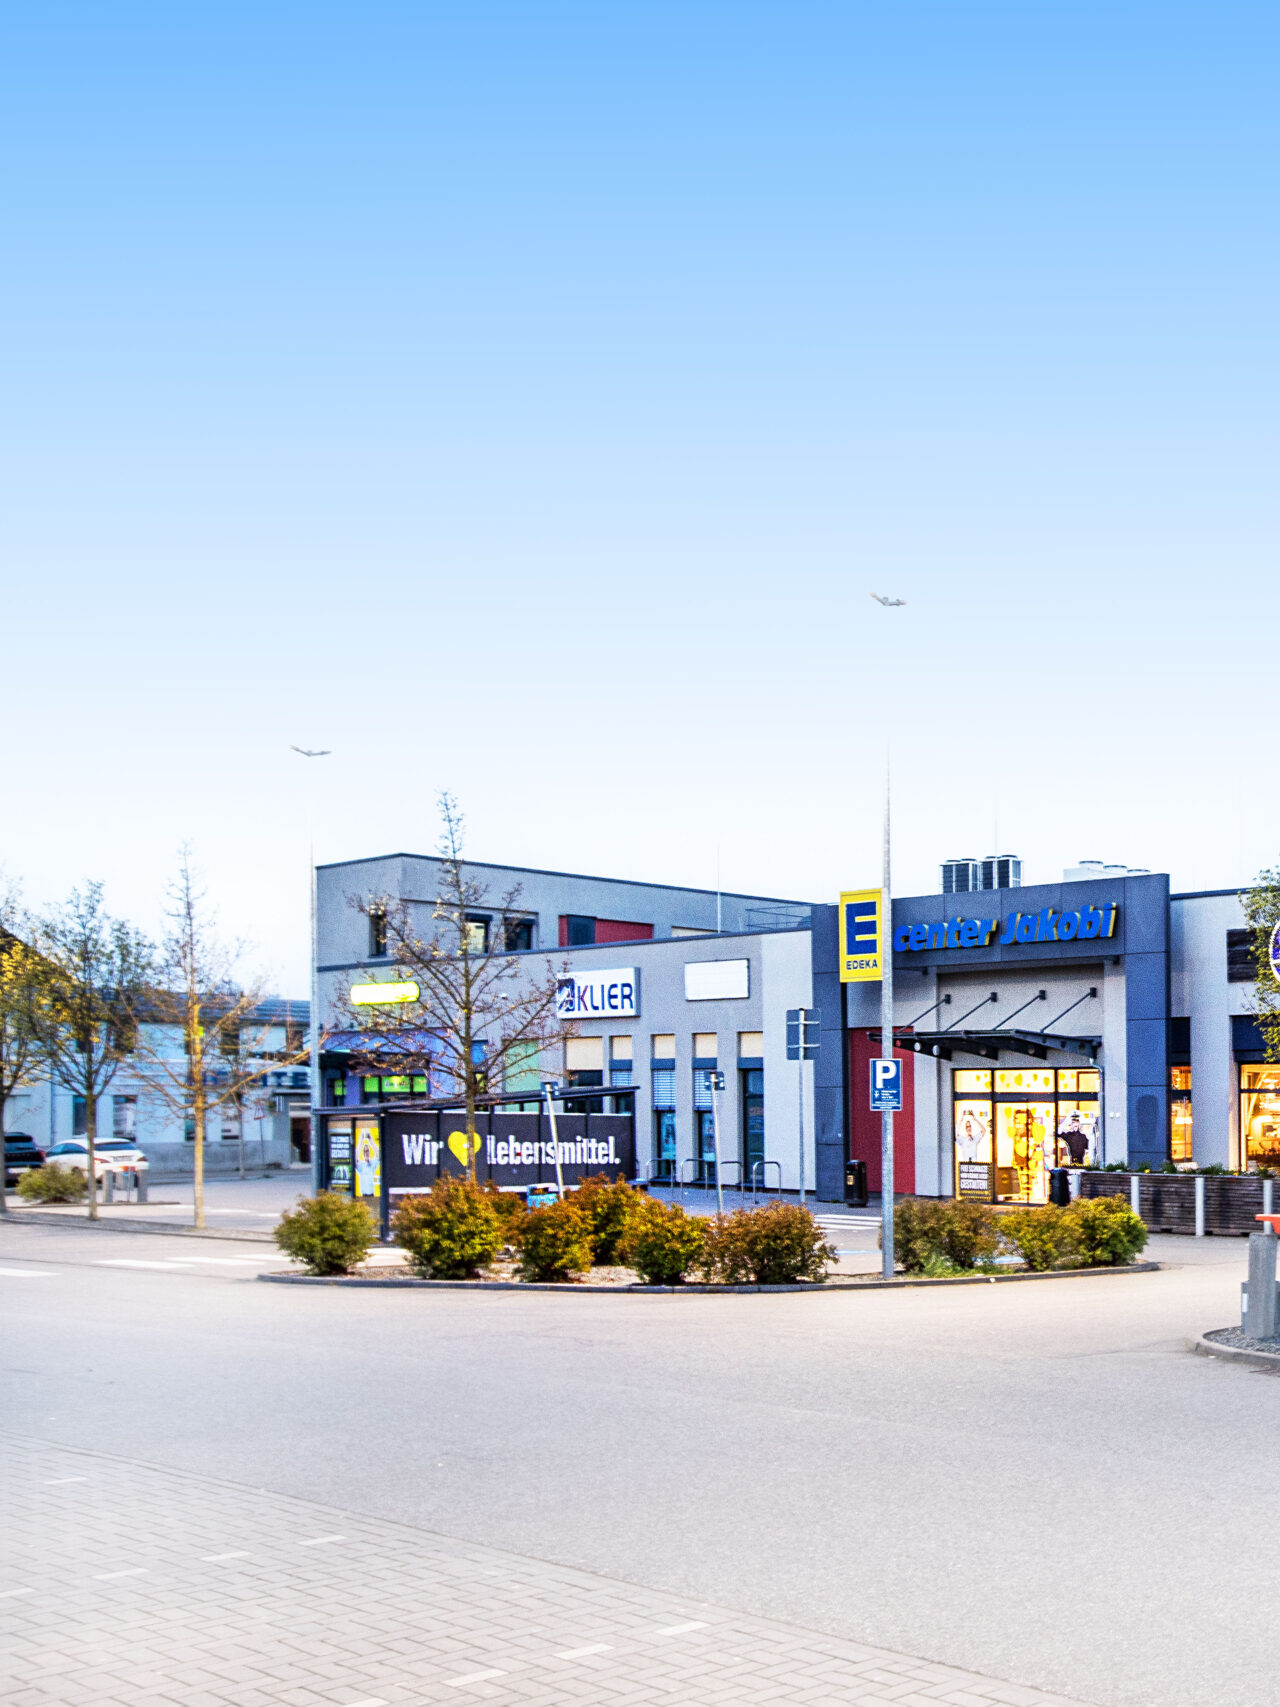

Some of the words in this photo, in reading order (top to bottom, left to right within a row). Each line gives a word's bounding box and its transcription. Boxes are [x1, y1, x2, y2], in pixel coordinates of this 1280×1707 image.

[846, 901, 878, 956] E
[893, 916, 999, 953] center
[1000, 902, 1118, 946] Jakobi
[846, 959, 879, 971] EDEKA
[577, 982, 634, 1012] KLIER
[876, 1060, 897, 1089] P
[402, 1133, 444, 1165] Wir
